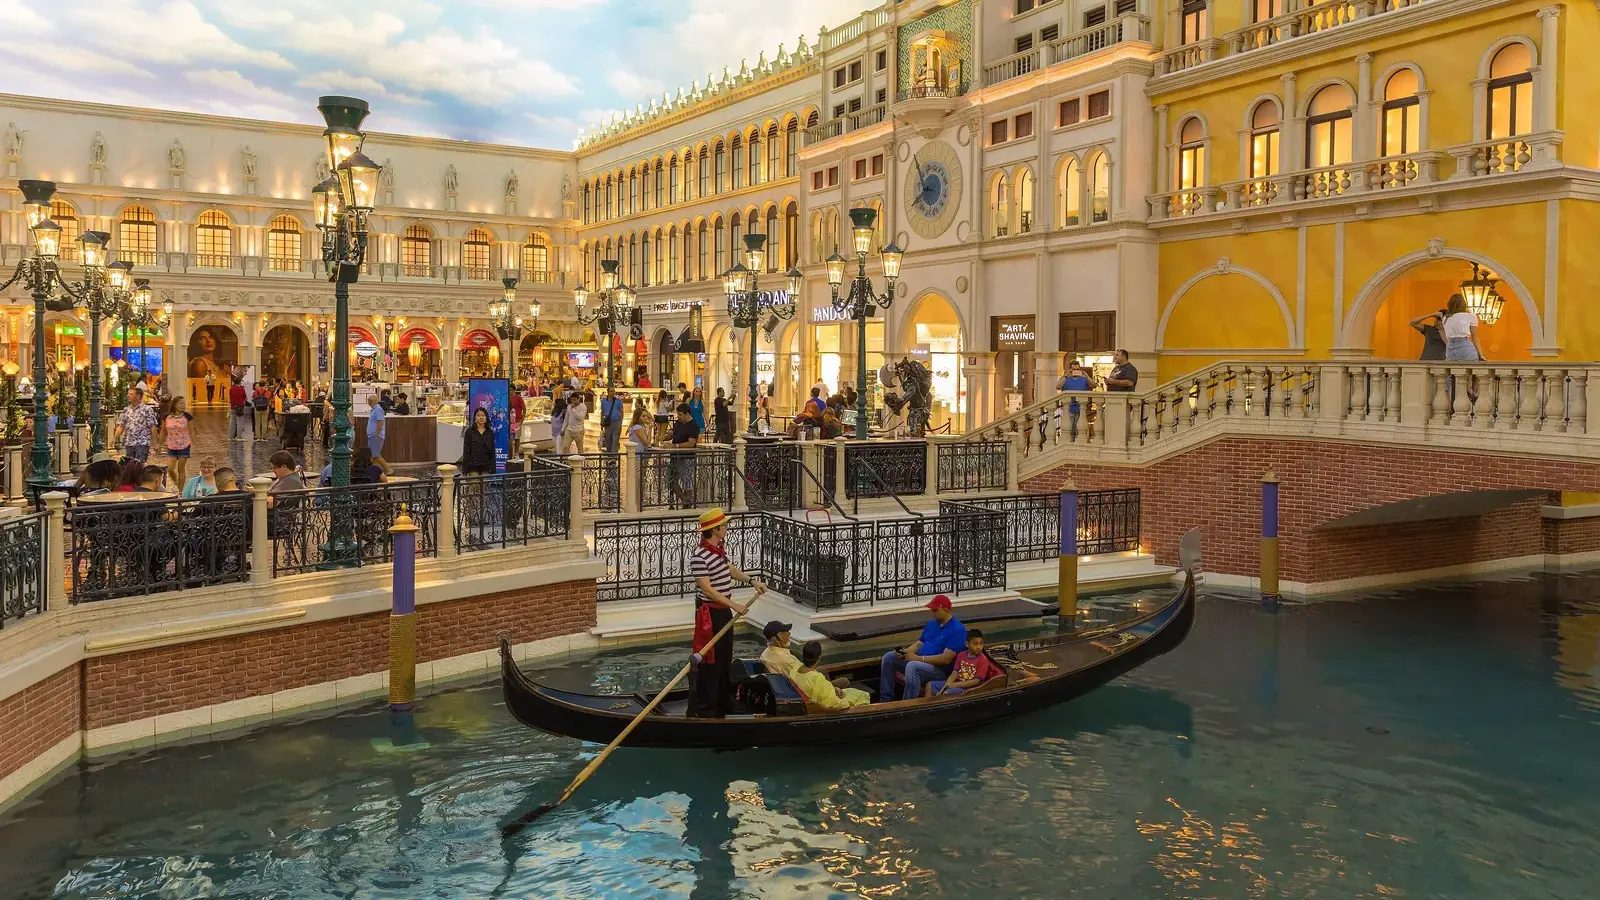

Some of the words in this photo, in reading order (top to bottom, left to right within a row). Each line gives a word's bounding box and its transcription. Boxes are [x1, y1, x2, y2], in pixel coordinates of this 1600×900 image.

[653, 303, 669, 312] PARIS
[813, 306, 854, 321] PANDO
[999, 332, 1035, 341] SHAVING
